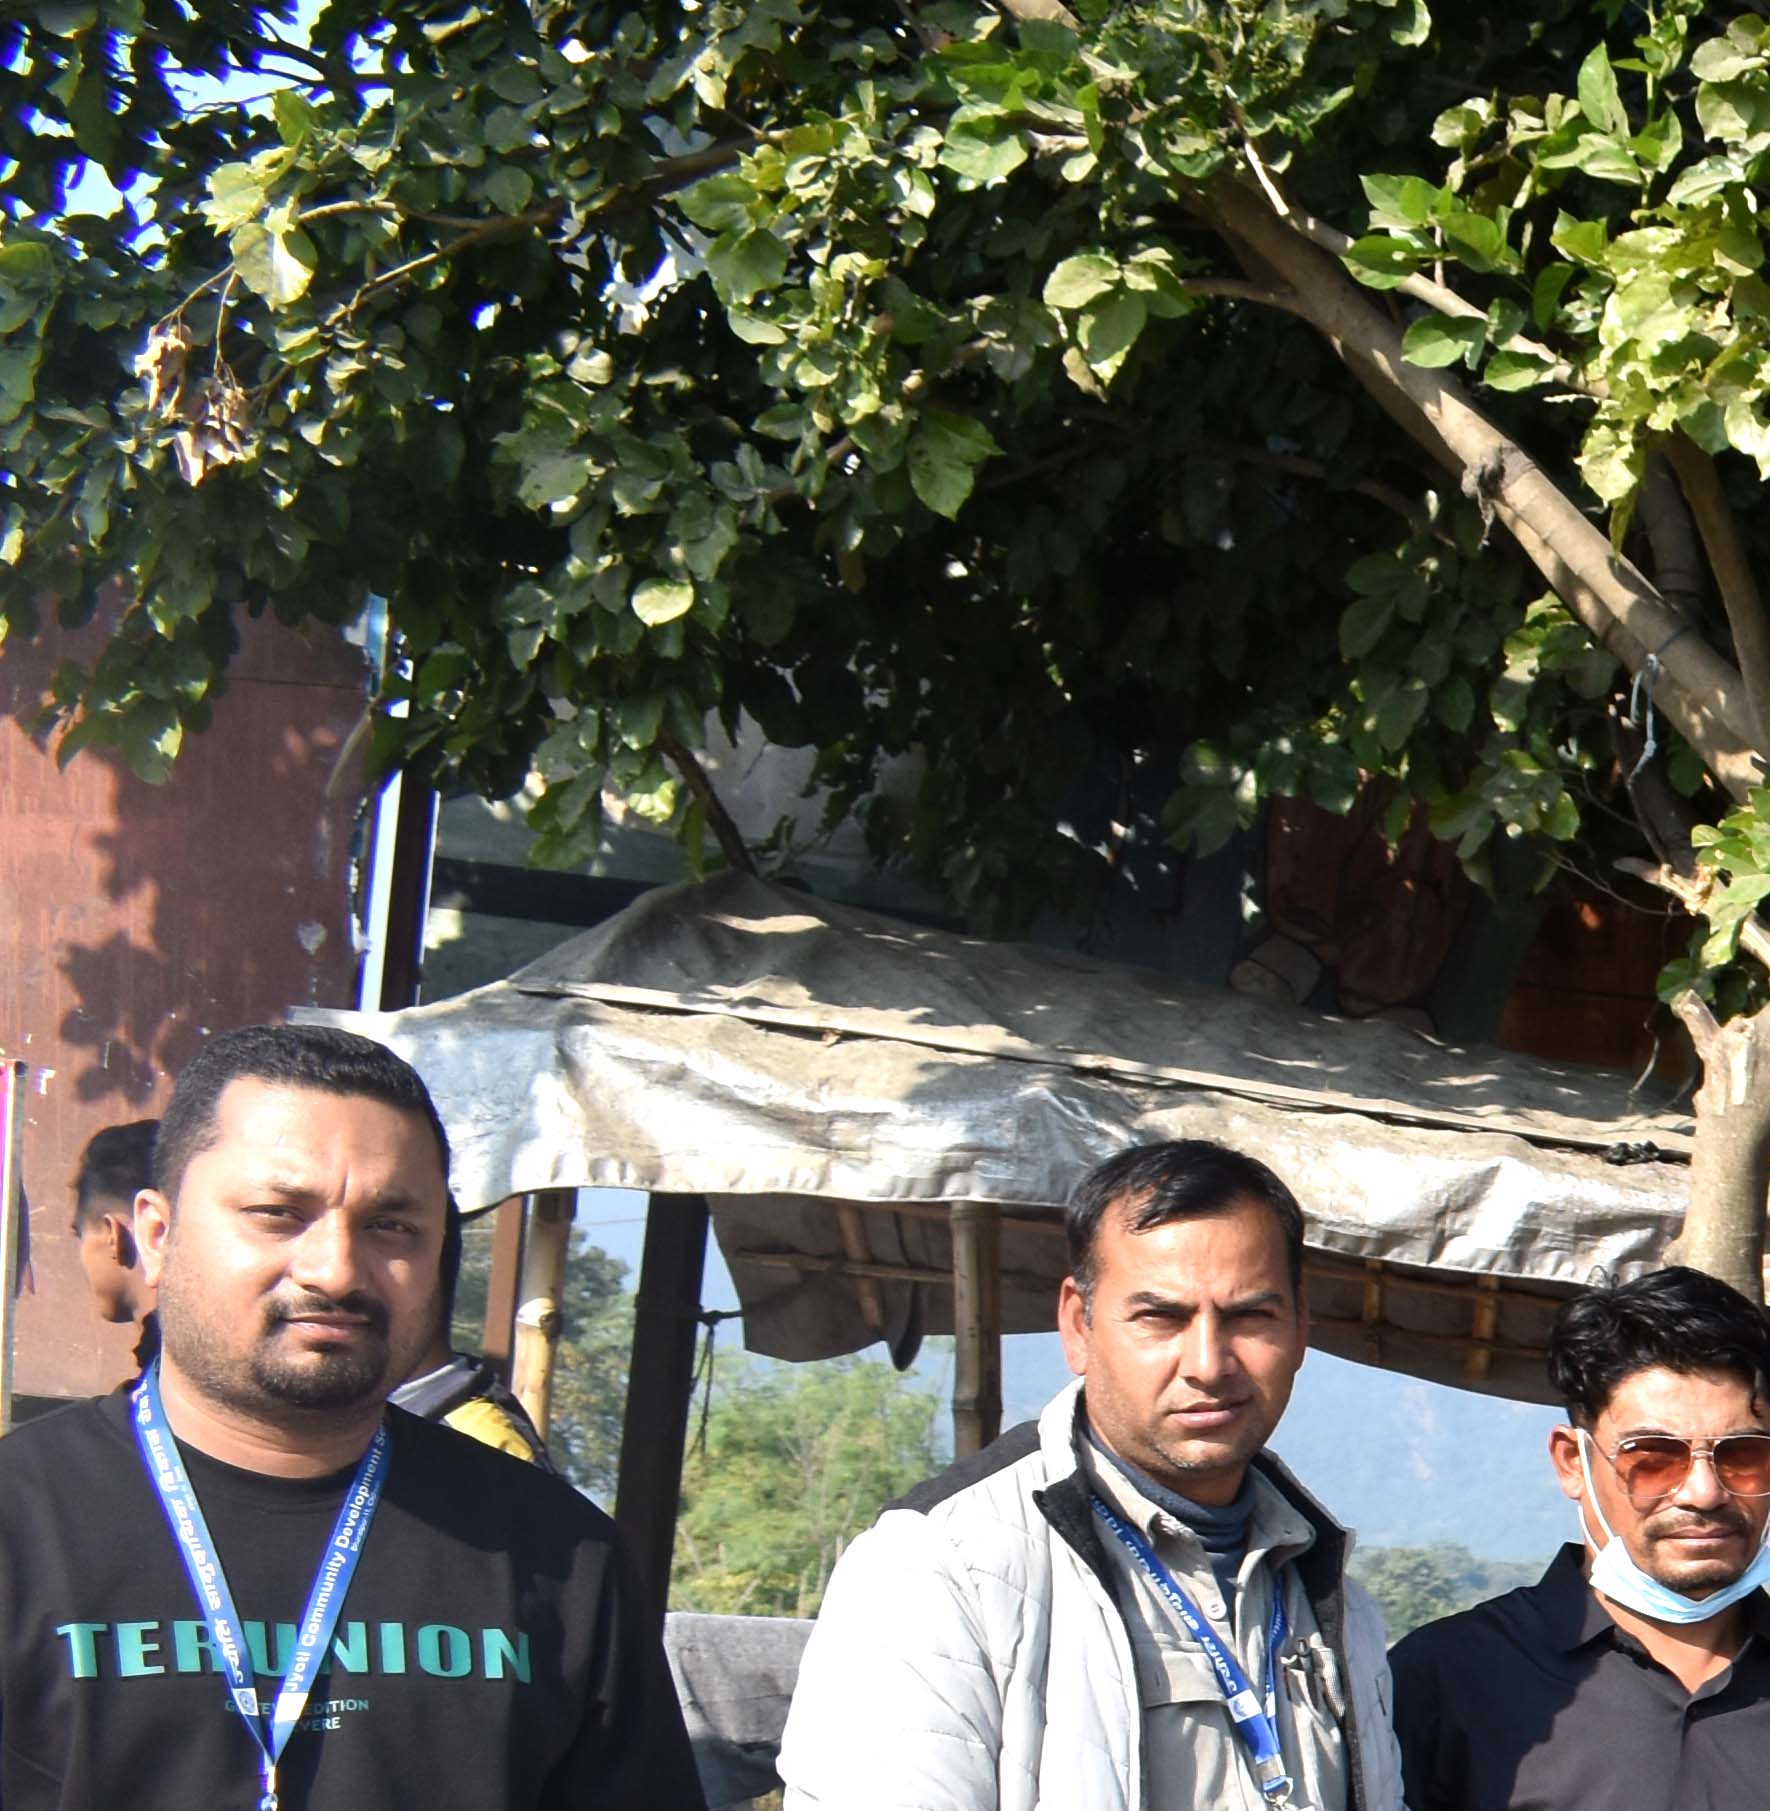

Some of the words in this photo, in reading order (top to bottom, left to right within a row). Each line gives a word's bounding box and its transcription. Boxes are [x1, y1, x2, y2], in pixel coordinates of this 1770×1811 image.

[285, 1651, 309, 1691] Jyoti
[302, 1551, 345, 1647] Community
[336, 1448, 383, 1548] Development
[56, 1620, 532, 1684] TERUNION
